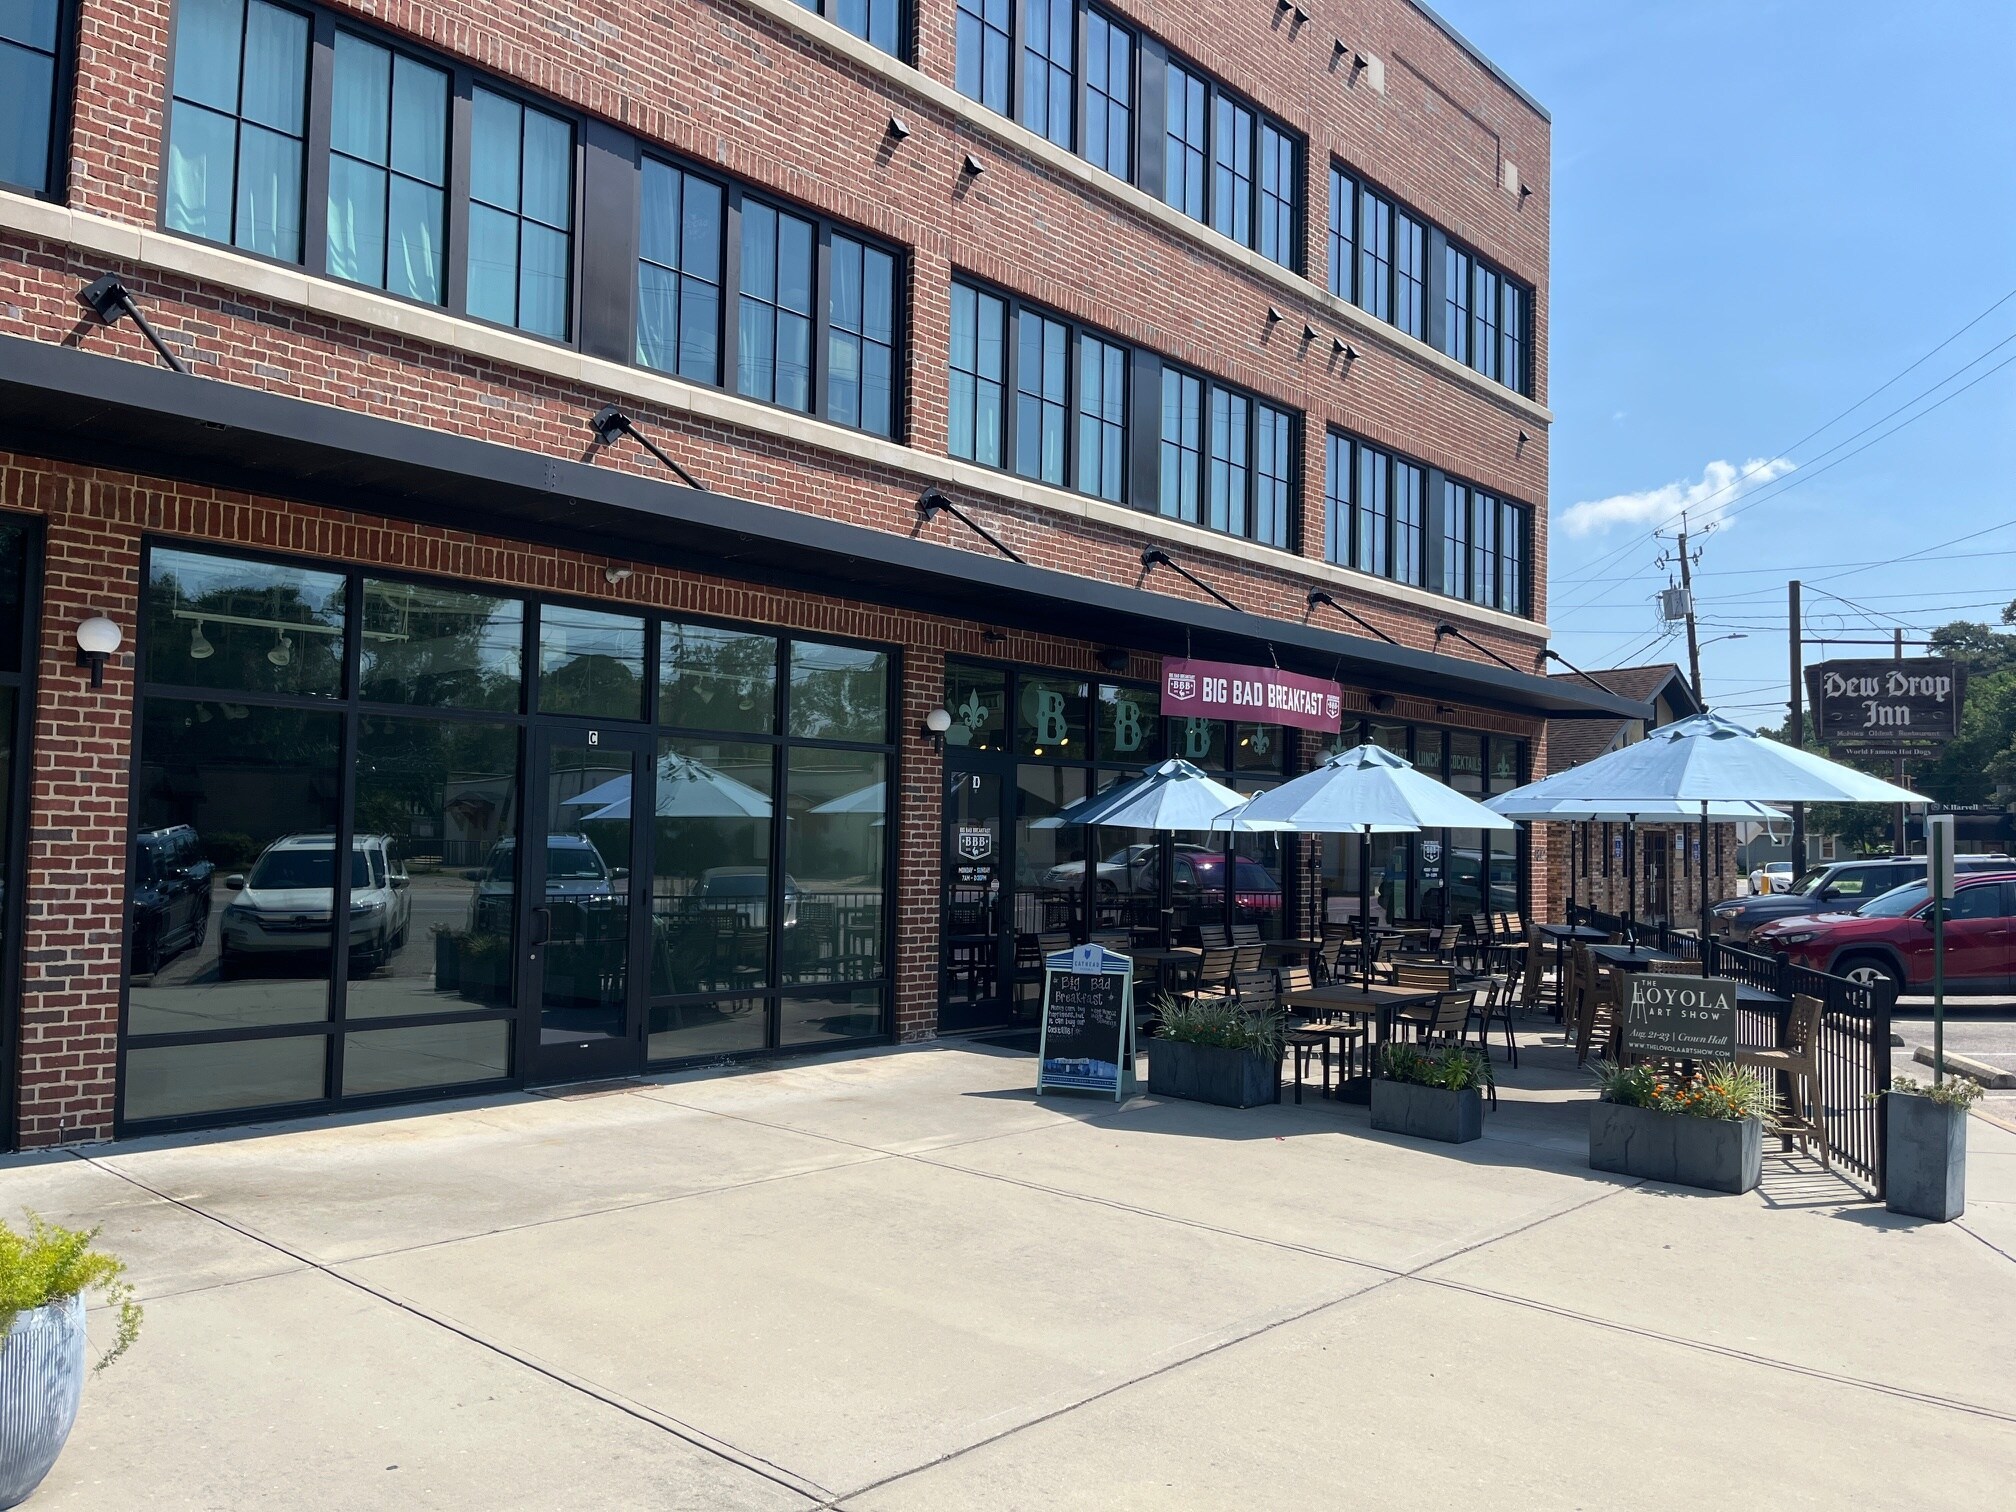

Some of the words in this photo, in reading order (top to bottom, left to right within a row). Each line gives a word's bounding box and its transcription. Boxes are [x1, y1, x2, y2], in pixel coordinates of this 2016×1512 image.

[1824, 672, 1879, 698] Dew
[1886, 670, 1950, 702] Drop
[1202, 677, 1227, 704] BIG
[1232, 680, 1263, 707] BAD
[1268, 684, 1323, 716] BREAKFAST
[1036, 689, 1068, 745] B
[1862, 701, 1911, 727] Inn
[1114, 700, 1142, 751] B
[590, 732, 596, 744] C
[1417, 751, 1439, 767] LUNCH
[973, 776, 980, 788] D
[966, 837, 985, 846] BBB
[1061, 976, 1080, 991] Big
[1091, 977, 1110, 990] Bad
[1055, 990, 1103, 1005] Breakfast
[1632, 982, 1730, 1010] LOYOLA
[1649, 1008, 1672, 1016] ART
[1681, 1010, 1719, 1020] SHOW
[1648, 1031, 1670, 1042] 21-23
[1678, 1033, 1706, 1042] Crown
[1707, 1035, 1728, 1045] Hall
[1628, 1042, 1730, 1057] WWW.THELOYOLAARTSHOW.COM
